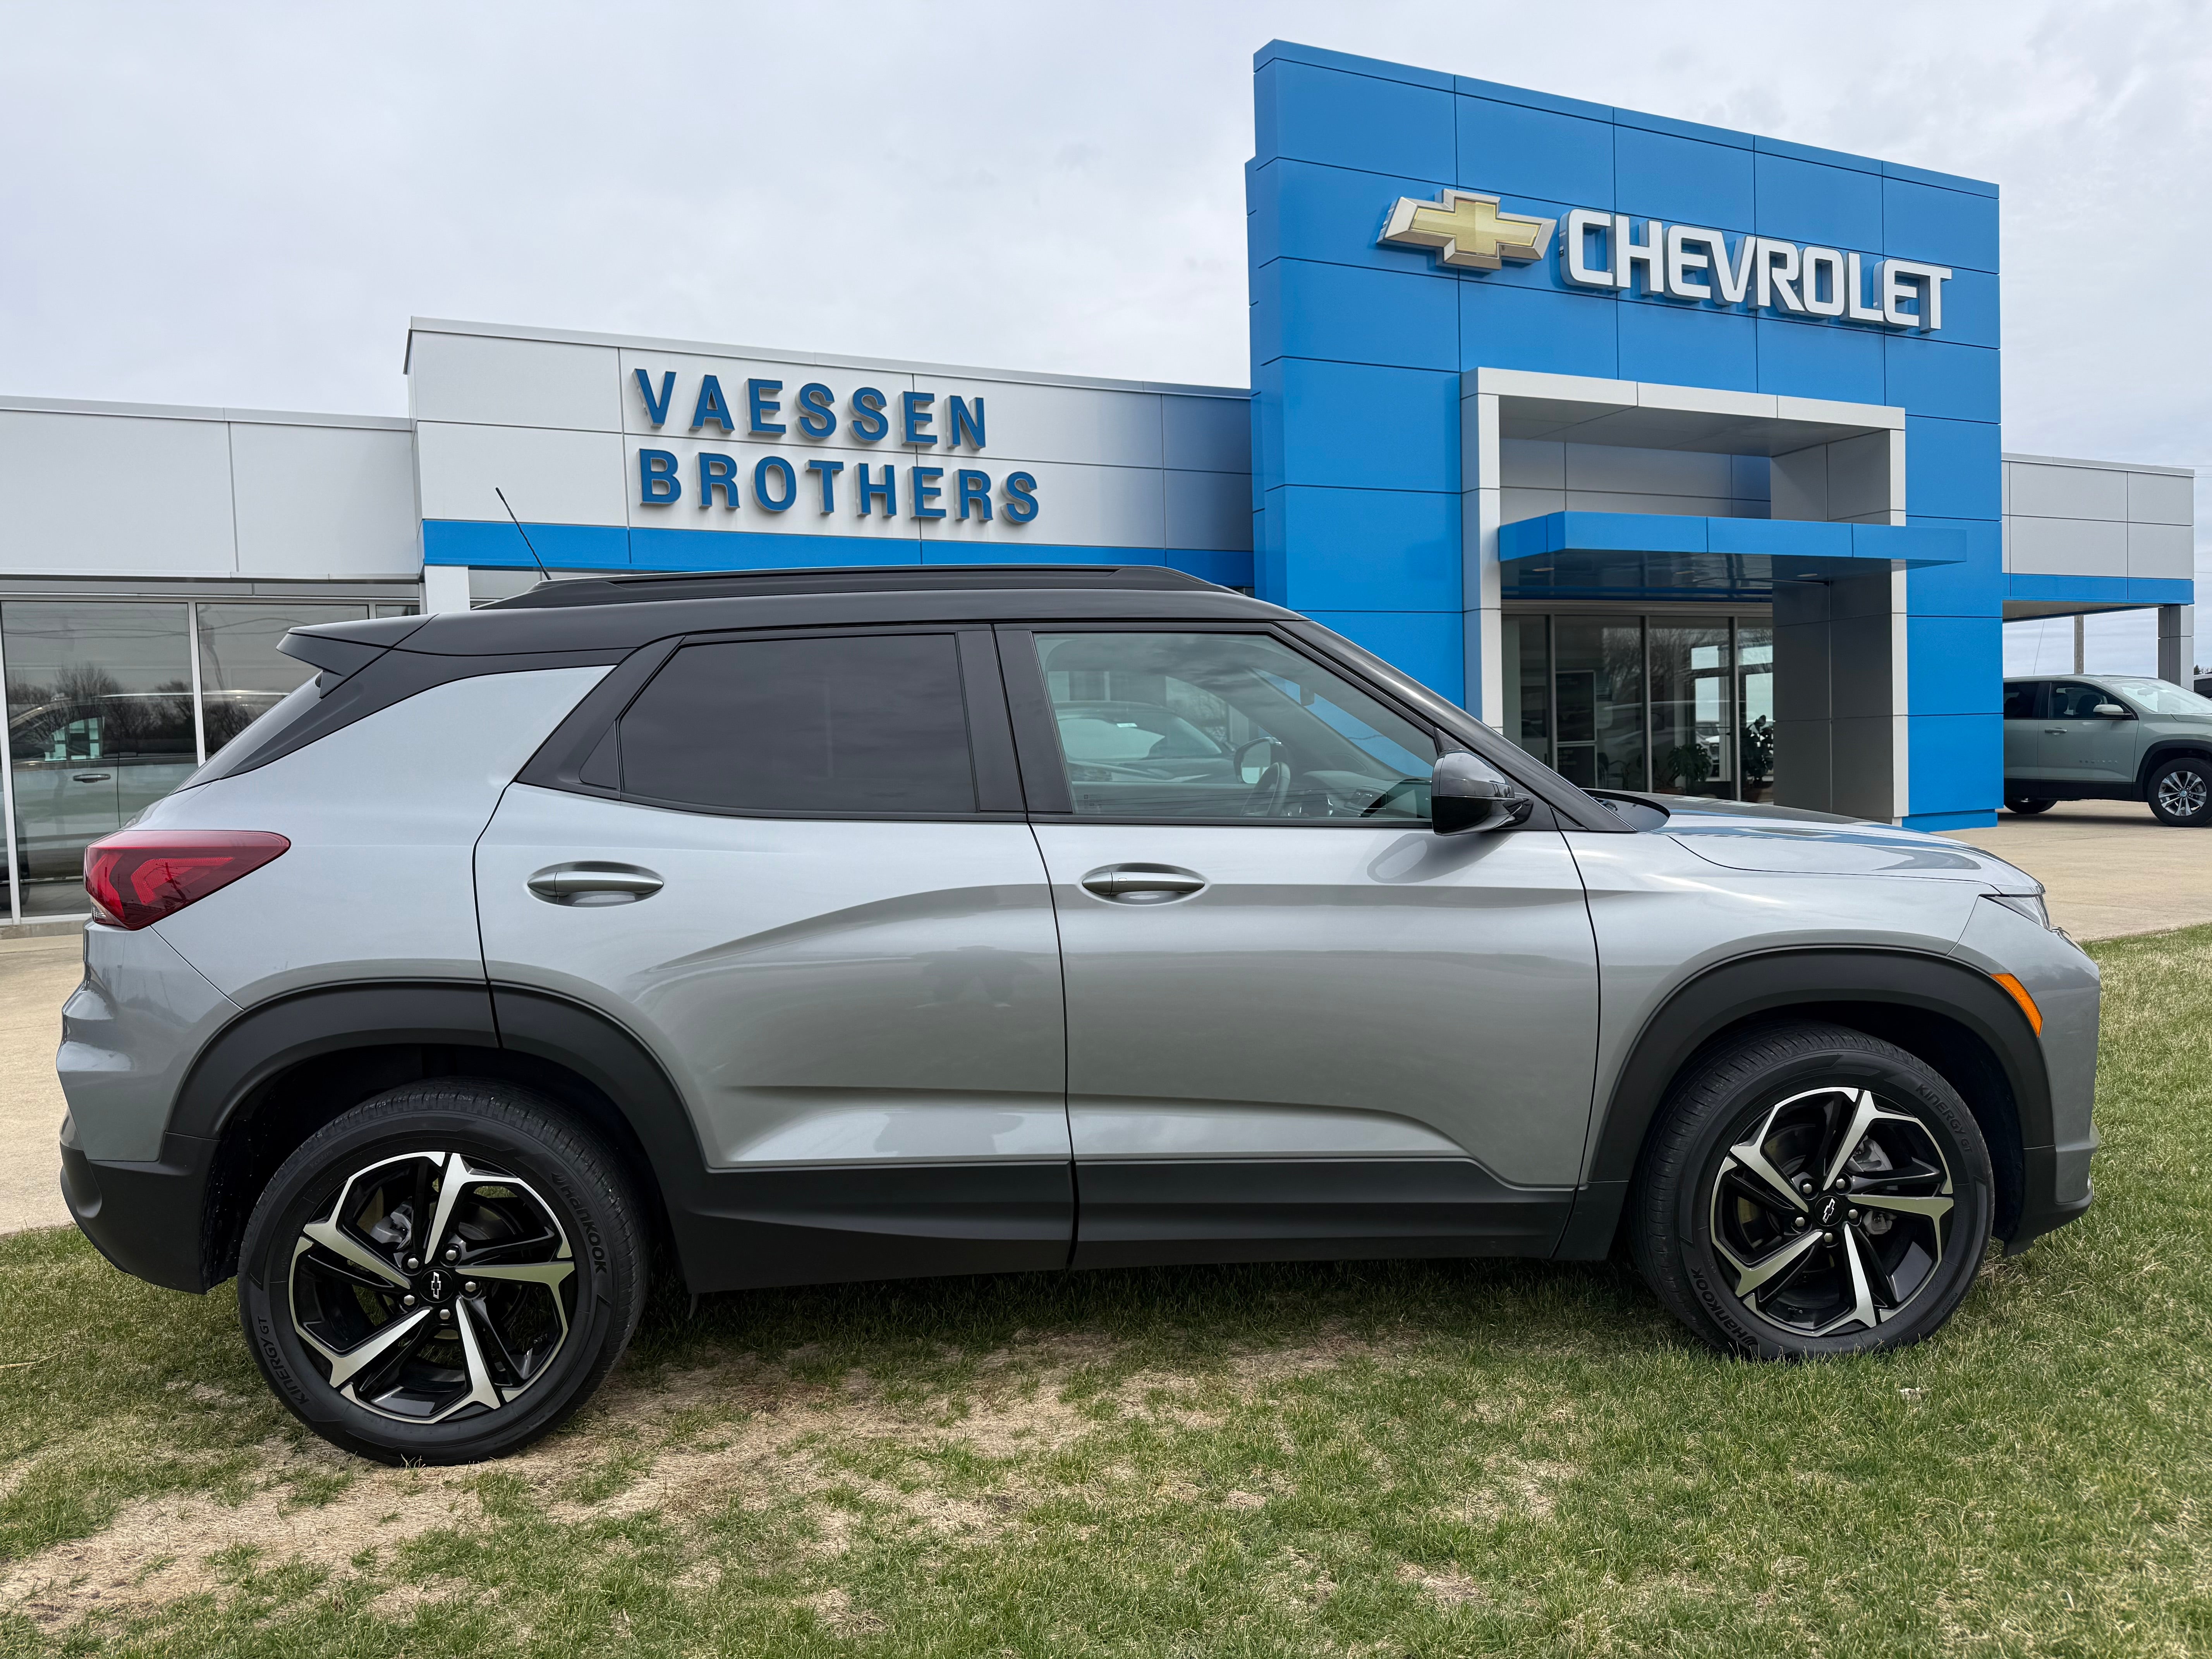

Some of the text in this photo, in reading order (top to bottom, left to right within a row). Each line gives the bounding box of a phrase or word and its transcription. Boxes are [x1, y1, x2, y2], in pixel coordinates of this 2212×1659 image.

[1559, 208, 1952, 333] CHEVROLET
[633, 368, 986, 450] VAESSEN
[638, 448, 1039, 525] BROTHERS
[1961, 1137, 1973, 1153] GT
[258, 1316, 310, 1405] KINERGY GT
